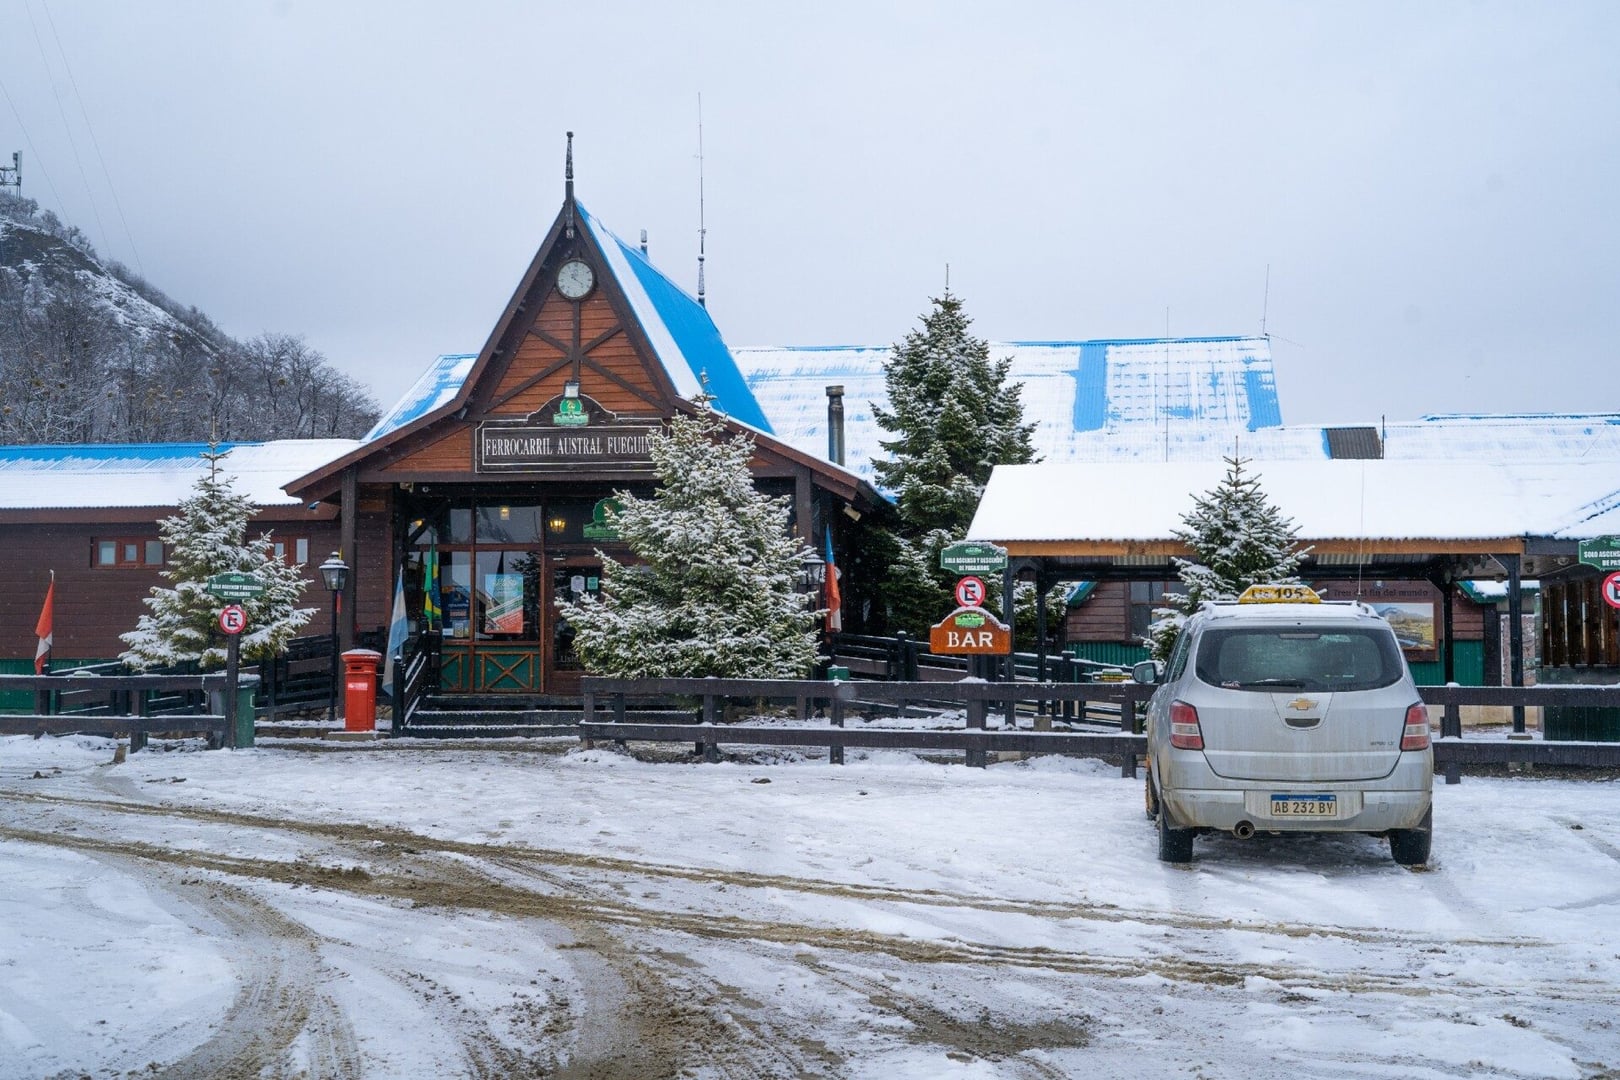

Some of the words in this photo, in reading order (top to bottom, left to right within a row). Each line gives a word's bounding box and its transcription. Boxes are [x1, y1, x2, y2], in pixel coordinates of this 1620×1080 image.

[485, 438, 553, 456] FERROCARRIL
[557, 437, 604, 455] AUSTRAL
[607, 436, 650, 454] FUEGUIN
[1275, 588, 1305, 599] 105
[946, 631, 993, 648] BAR
[1274, 801, 1289, 814] AB
[1292, 801, 1315, 814] 232
[1318, 801, 1333, 814] BY
